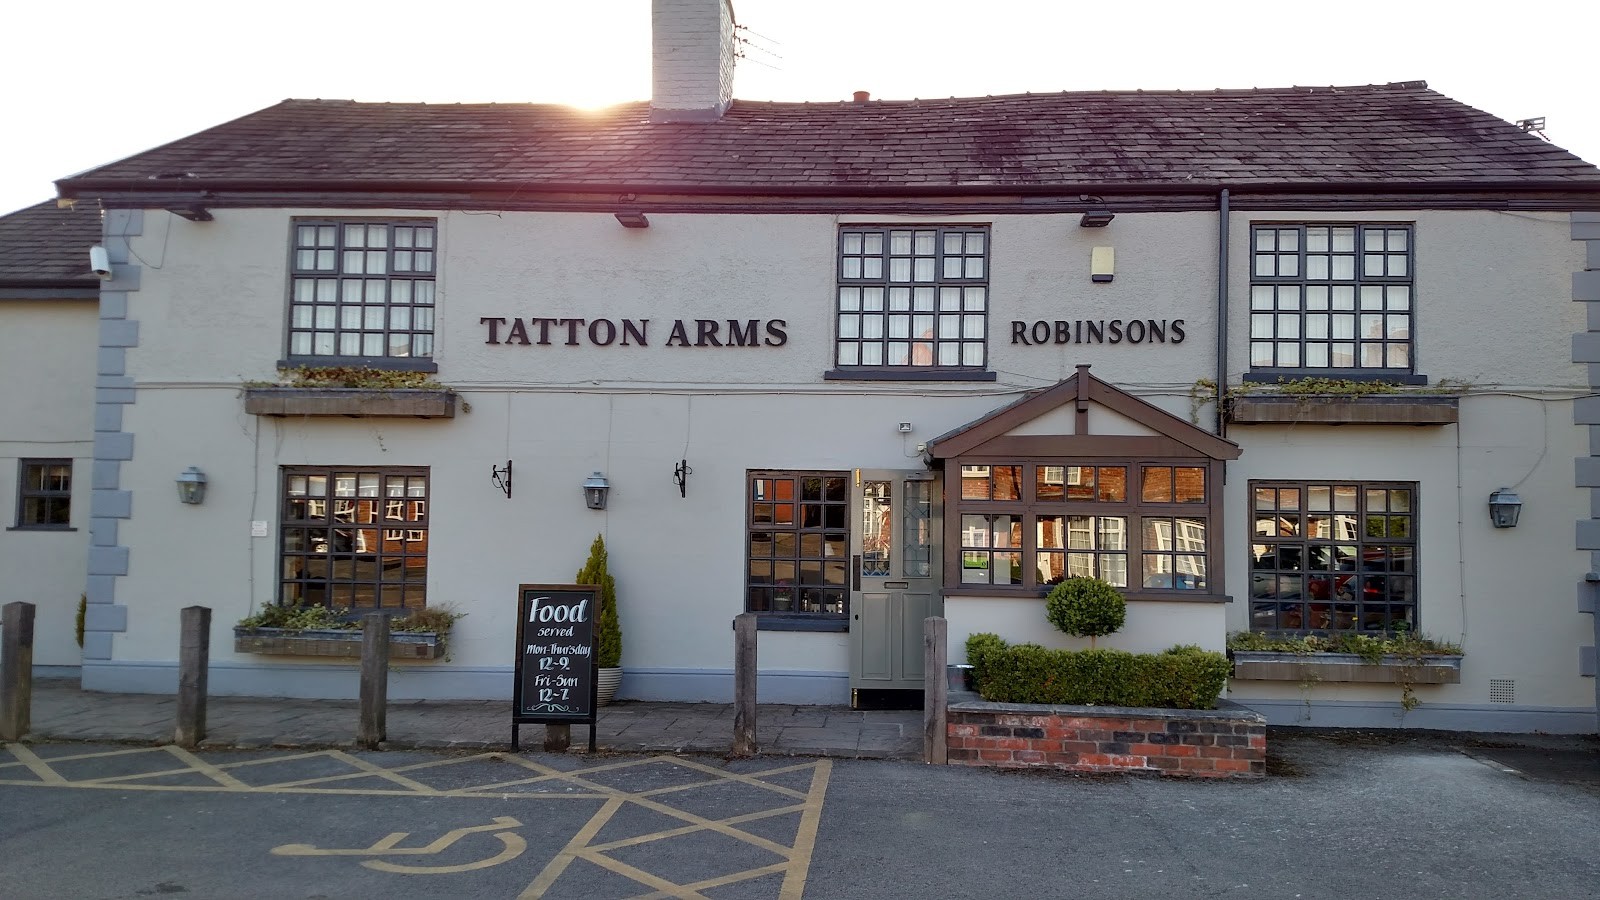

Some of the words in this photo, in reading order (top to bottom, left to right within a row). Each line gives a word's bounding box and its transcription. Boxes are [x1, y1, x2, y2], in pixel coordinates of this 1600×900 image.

[480, 317, 649, 346] TATTON
[665, 319, 788, 347] ARMS
[1011, 319, 1186, 346] ROBINSONS
[529, 596, 588, 623] Food
[537, 626, 574, 637] served
[526, 643, 591, 659] Mon-Thursday
[534, 674, 578, 687] Fri-Sun
